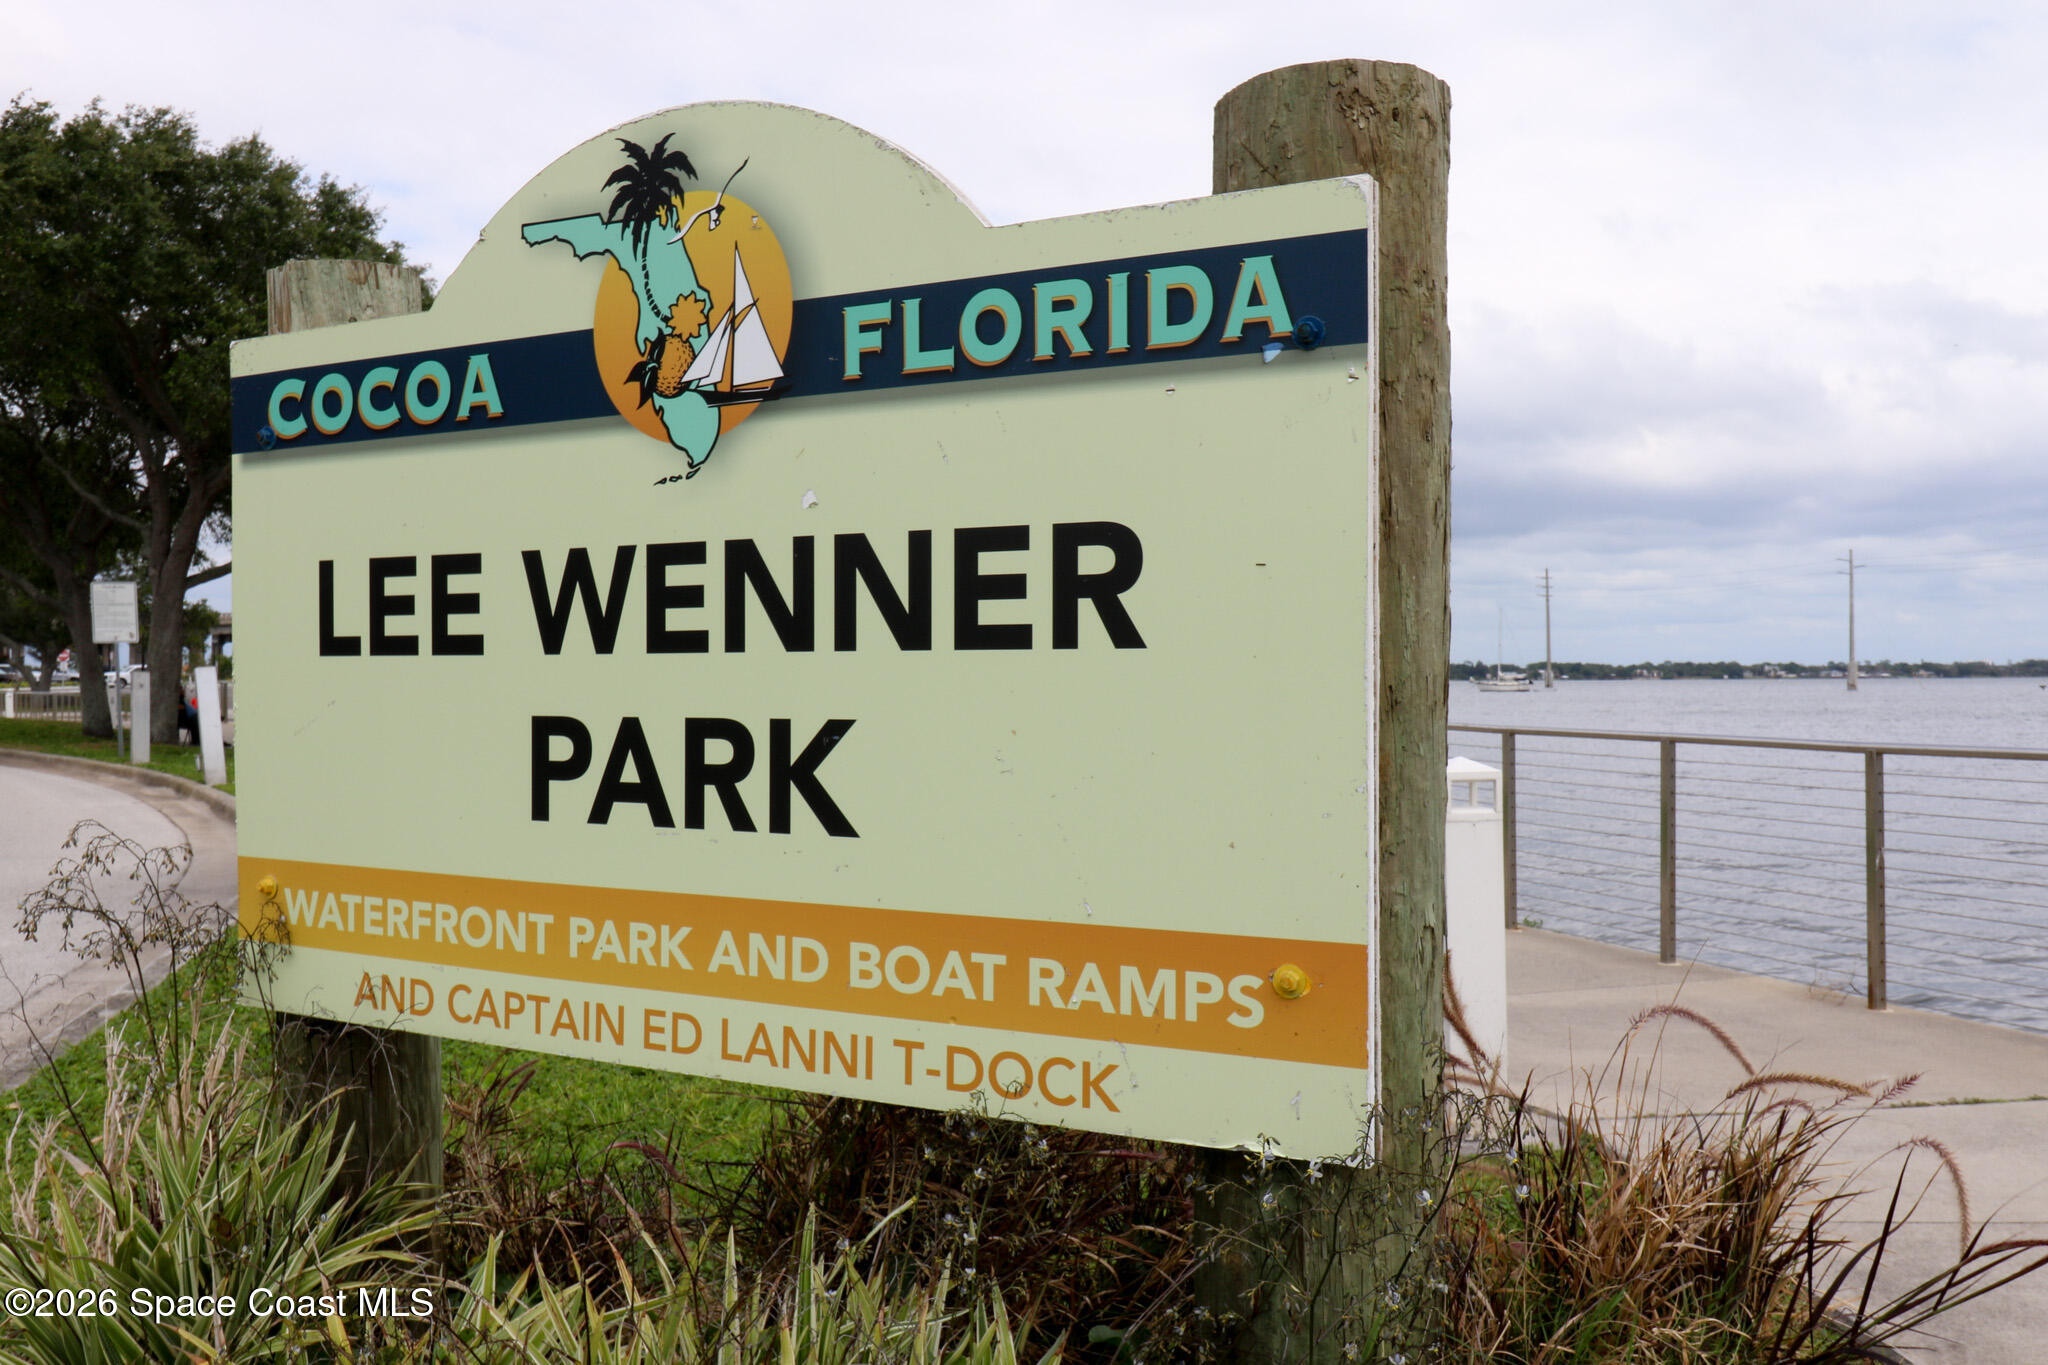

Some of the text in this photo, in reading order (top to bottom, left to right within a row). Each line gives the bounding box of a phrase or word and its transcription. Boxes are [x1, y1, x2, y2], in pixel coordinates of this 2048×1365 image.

[267, 255, 1294, 439] COCOA FLORIDA
[318, 520, 1148, 657] LEE WENNER
[531, 715, 861, 838] PARK
[284, 888, 1265, 1029] WATERFRONT PARK AND BOAT RAMPS
[354, 971, 1120, 1113] AND CAPTAIN ED LANNI T-DOCK
